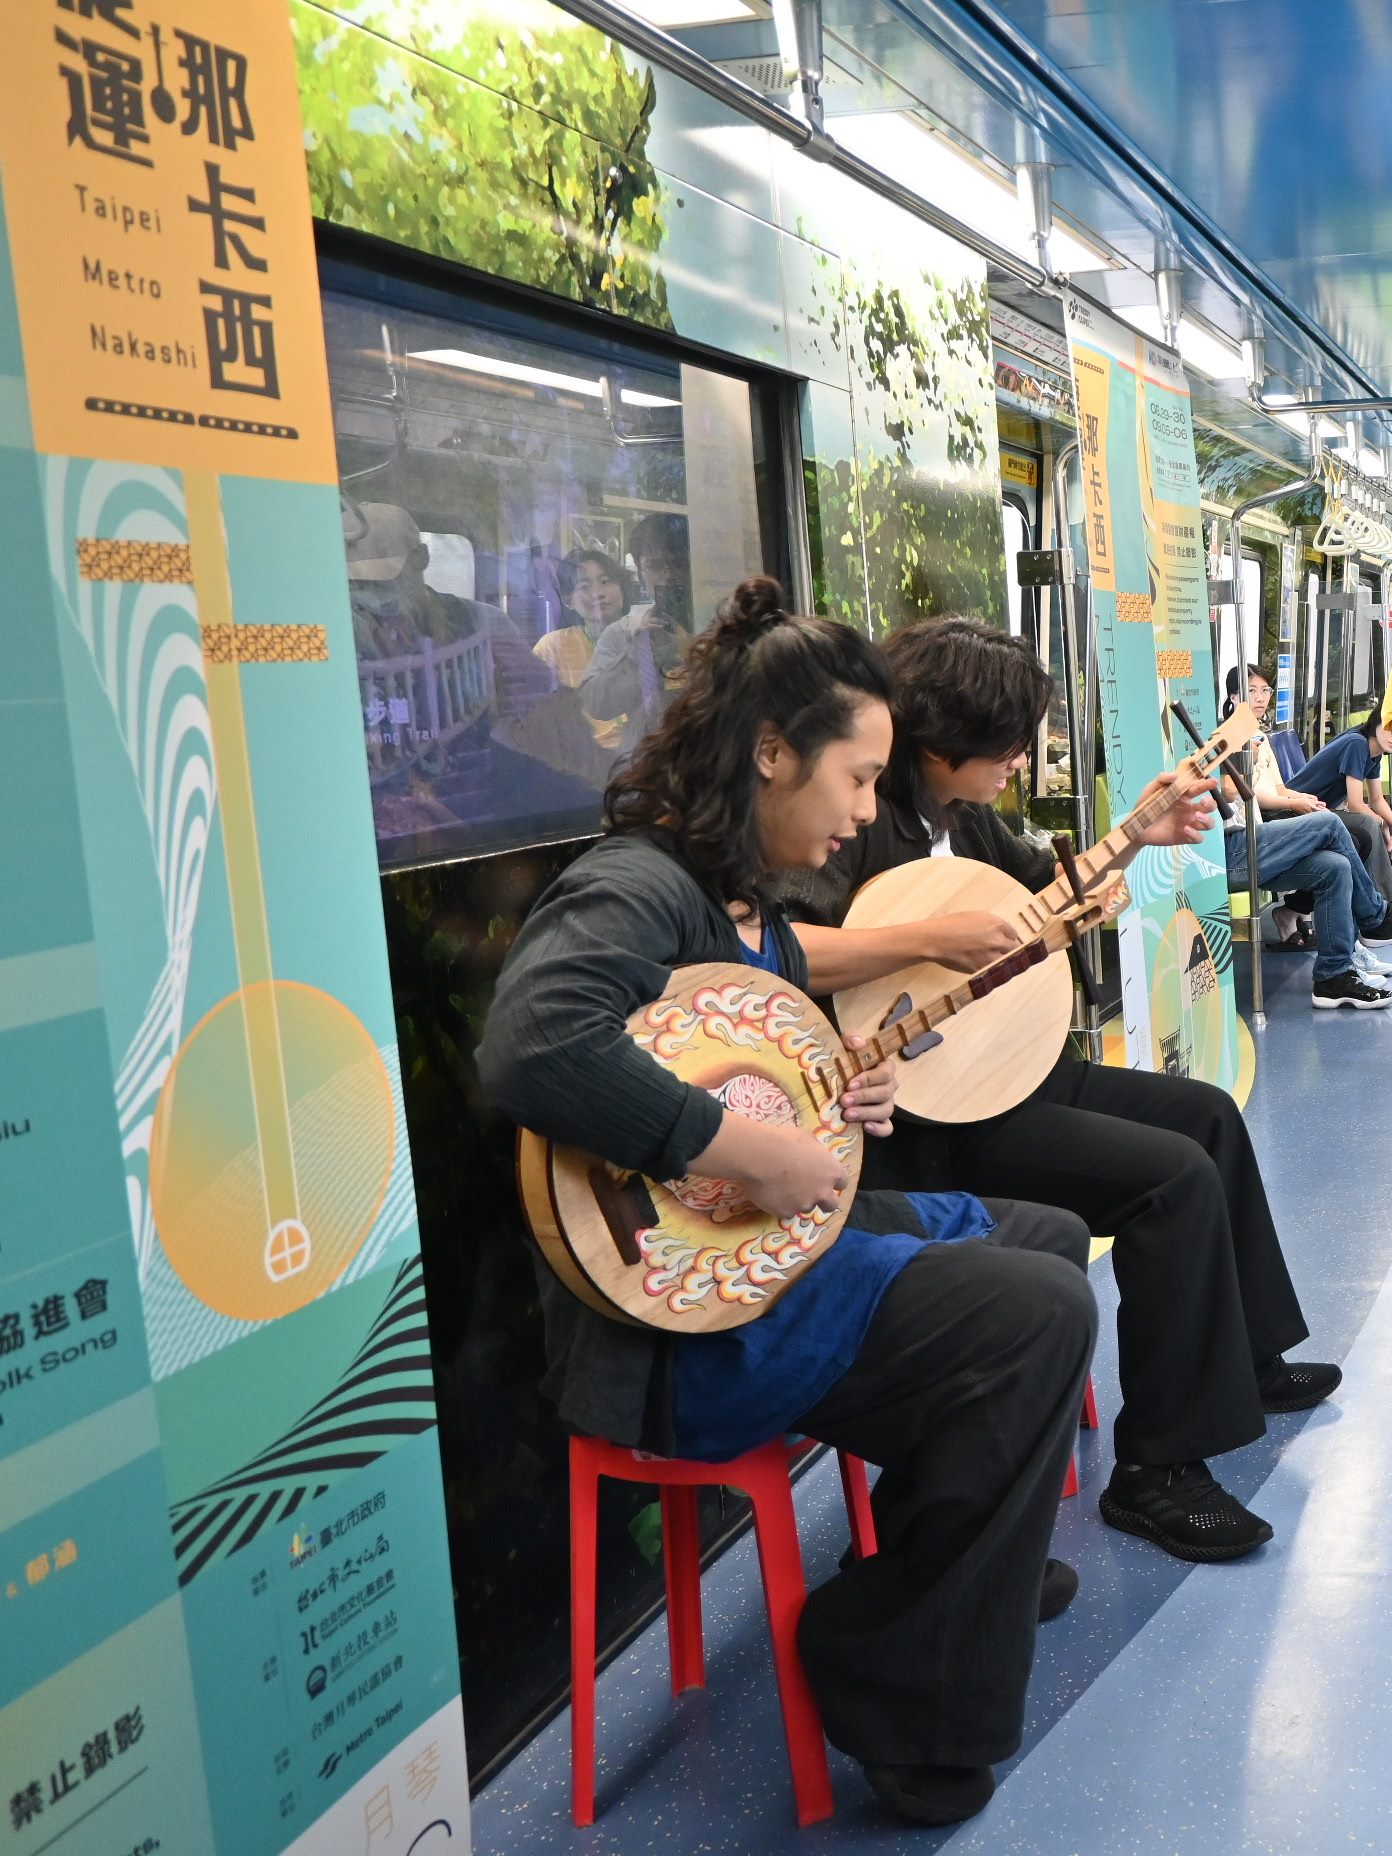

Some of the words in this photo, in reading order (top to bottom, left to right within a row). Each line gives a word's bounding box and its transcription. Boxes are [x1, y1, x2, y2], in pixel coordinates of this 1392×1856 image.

[74, 184, 162, 235] Taipei
[173, 27, 282, 401] 那卡西
[82, 255, 162, 300] Metro
[89, 322, 198, 370] Nakashi
[1085, 413, 1107, 558] 那卡西
[1102, 613, 1128, 806] TRENDY
[39, 1327, 118, 1374] Song
[319, 1490, 387, 1549] 臺北市政府
[345, 1725, 374, 1756] Metro
[374, 1697, 404, 1731] Taipei
[8, 1704, 146, 1831] 禁止錄影
